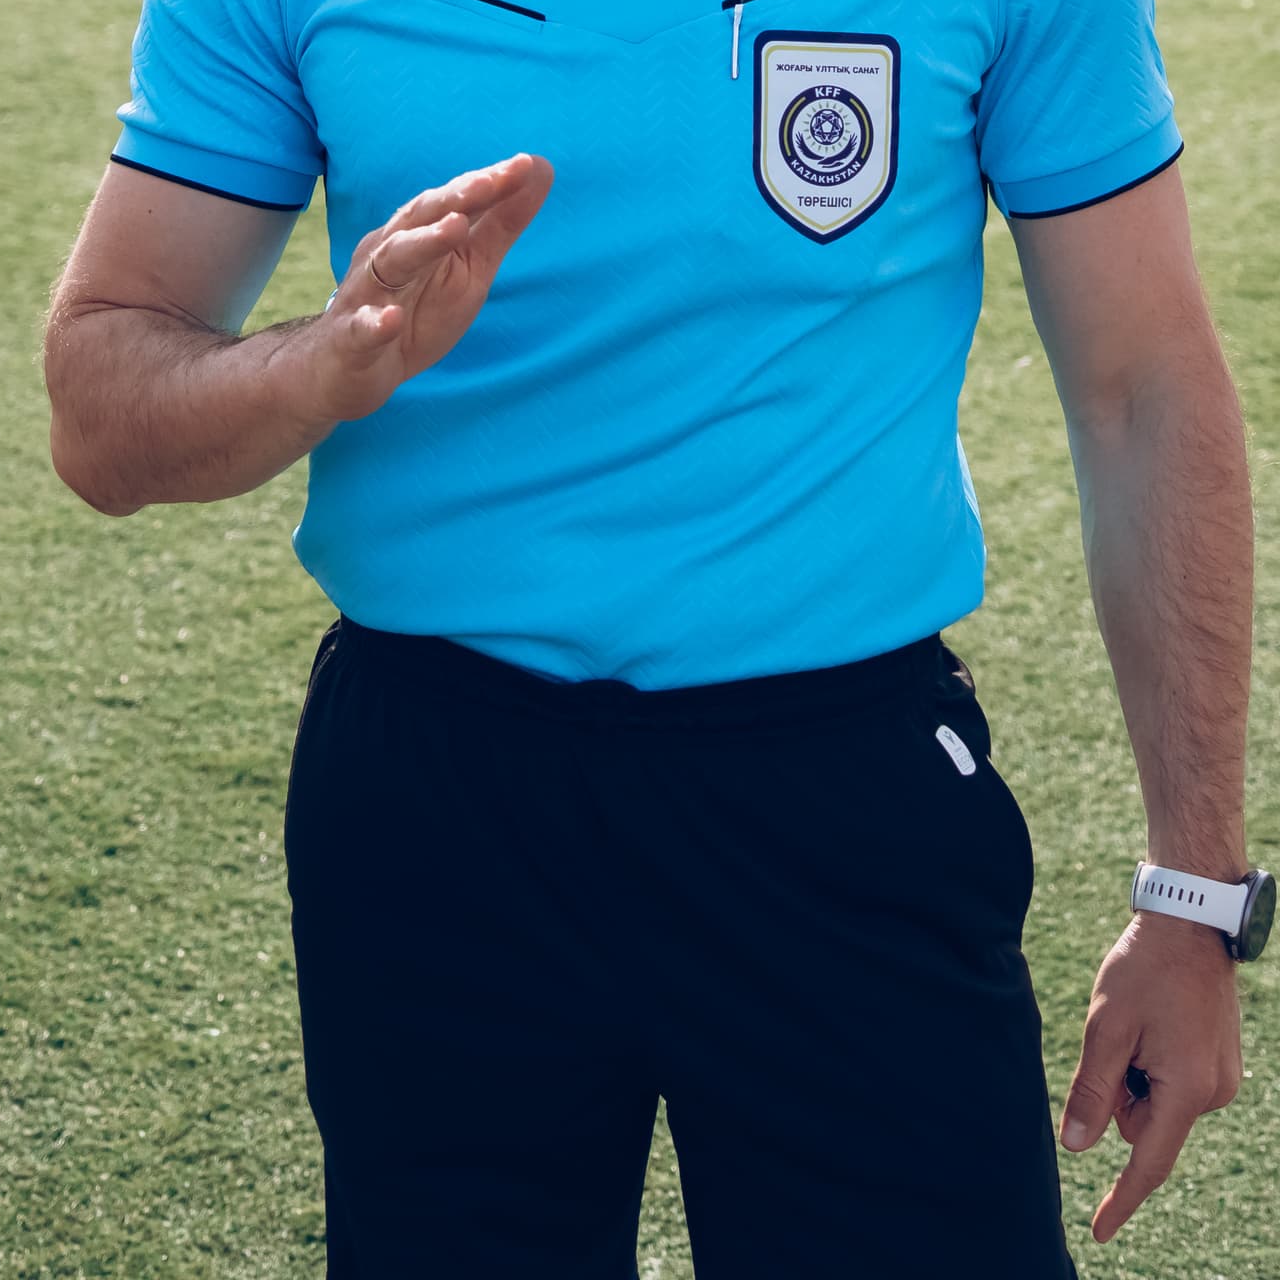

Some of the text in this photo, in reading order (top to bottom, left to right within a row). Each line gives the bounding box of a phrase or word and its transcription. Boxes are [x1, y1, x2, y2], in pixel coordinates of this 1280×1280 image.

[852, 66, 880, 75] САНАТ
[814, 86, 841, 98] KFF
[791, 159, 862, 184] KAZAKHSTAN
